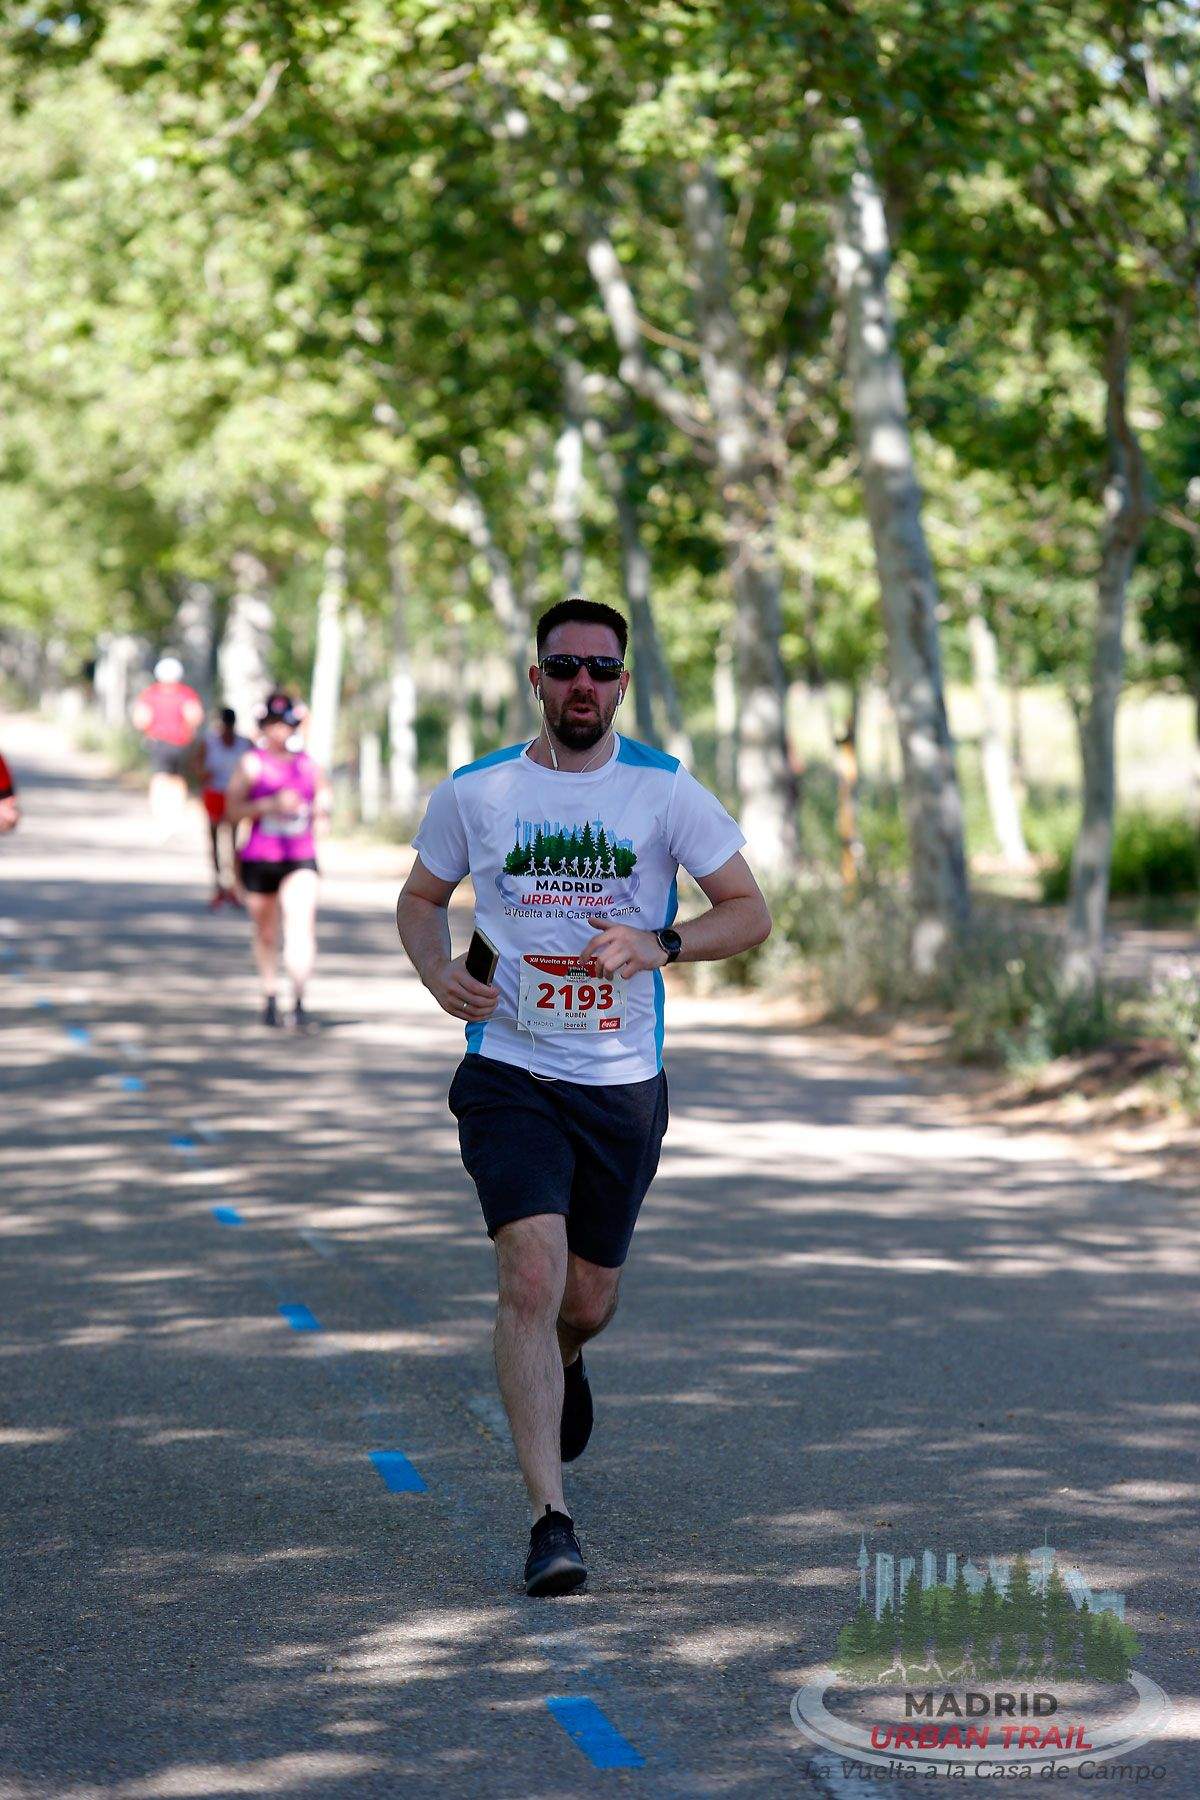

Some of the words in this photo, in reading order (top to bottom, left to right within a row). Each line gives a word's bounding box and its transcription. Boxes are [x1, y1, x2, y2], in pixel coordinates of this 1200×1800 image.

[535, 880, 603, 893] MADRID
[521, 894, 572, 906] URBAN
[577, 895, 614, 906] TRAIL
[511, 908, 542, 918] Vuelta
[555, 909, 564, 918] la
[566, 910, 592, 920] Casa
[595, 910, 608, 919] de
[610, 906, 641, 917] Campo
[536, 982, 614, 1011] 2193
